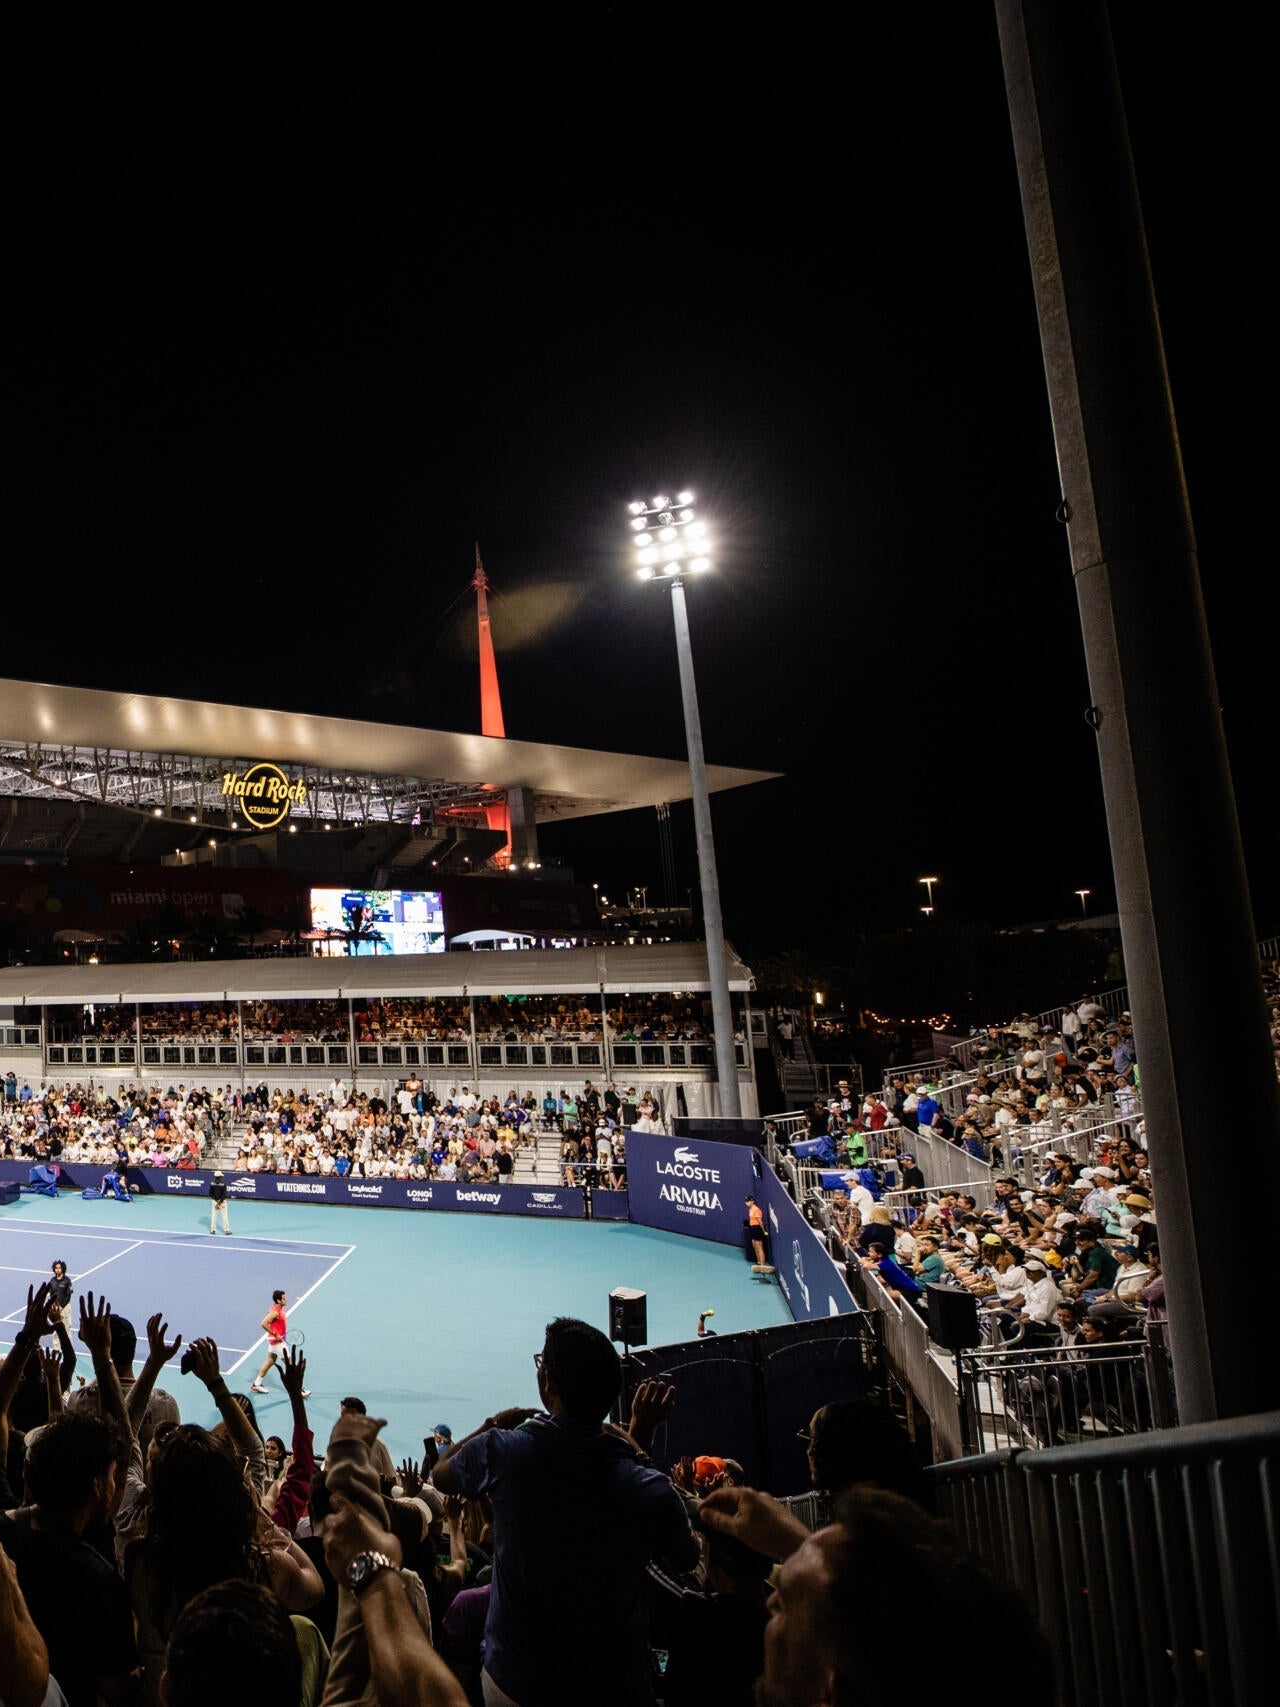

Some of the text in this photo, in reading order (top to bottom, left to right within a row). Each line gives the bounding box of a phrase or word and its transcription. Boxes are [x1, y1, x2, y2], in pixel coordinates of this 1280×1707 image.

[221, 772, 307, 805] Hard Rock
[248, 805, 279, 815] STADIUM
[110, 887, 215, 909] miami open
[656, 1160, 721, 1184] LACOSTE
[276, 1182, 326, 1194] WTATENNIS.COM
[348, 1184, 382, 1193] Laykold
[456, 1189, 501, 1205] betway
[676, 1204, 706, 1216] COLOSTRUM
